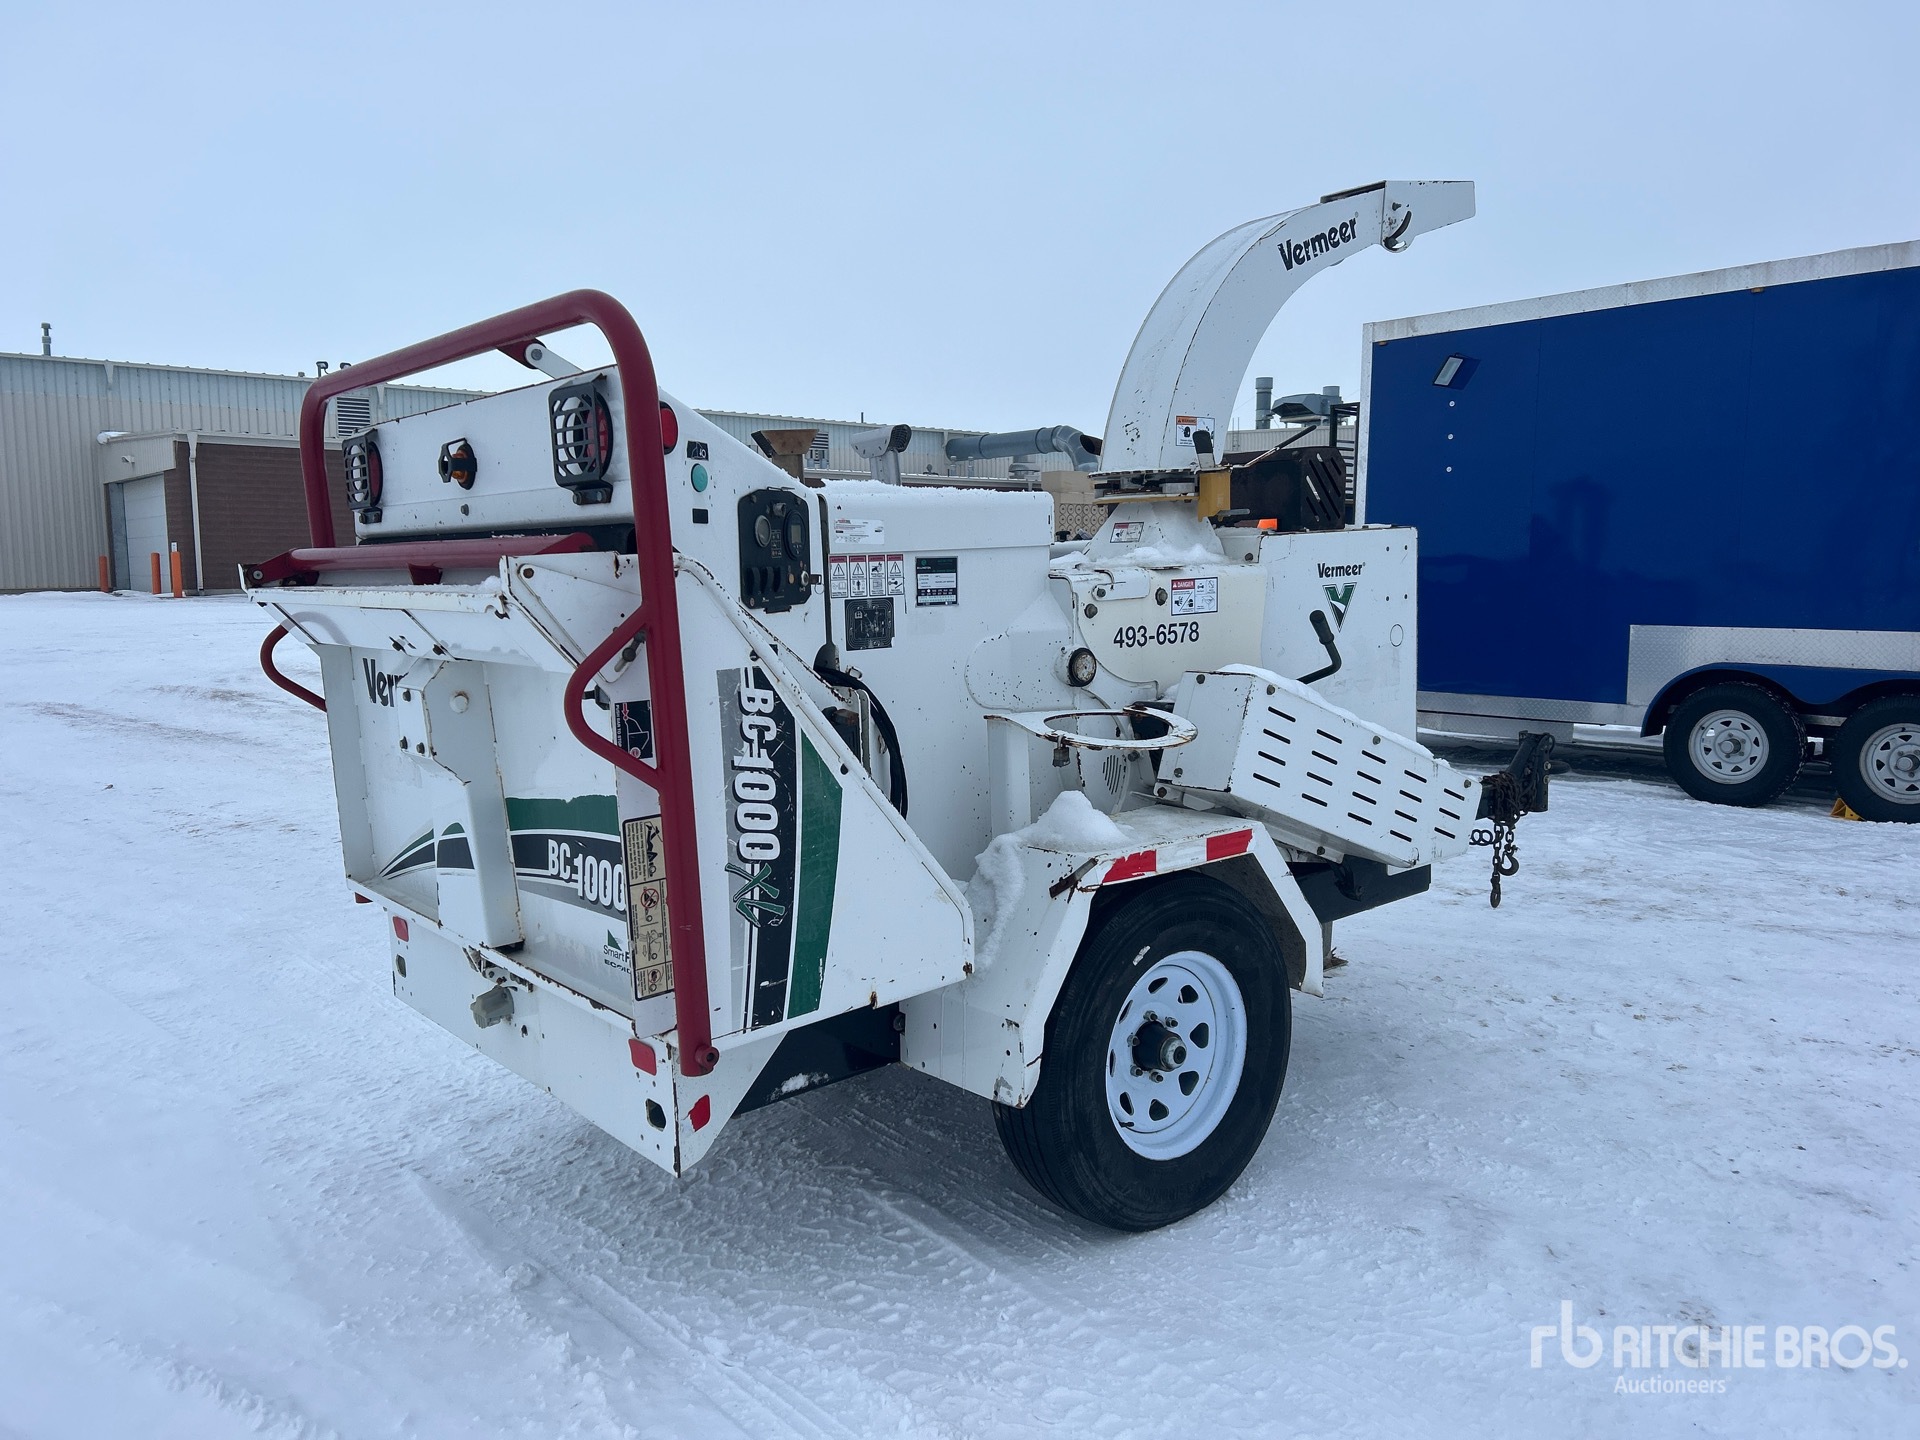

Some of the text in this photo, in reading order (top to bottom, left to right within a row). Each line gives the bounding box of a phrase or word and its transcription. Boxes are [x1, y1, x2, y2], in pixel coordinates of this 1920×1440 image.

[1277, 217, 1357, 271] Vermeer
[1317, 563, 1362, 578] Vermeer
[1113, 621, 1199, 648] 493-6578
[732, 688, 781, 861] BC-1000
[548, 839, 627, 912] BC-1000
